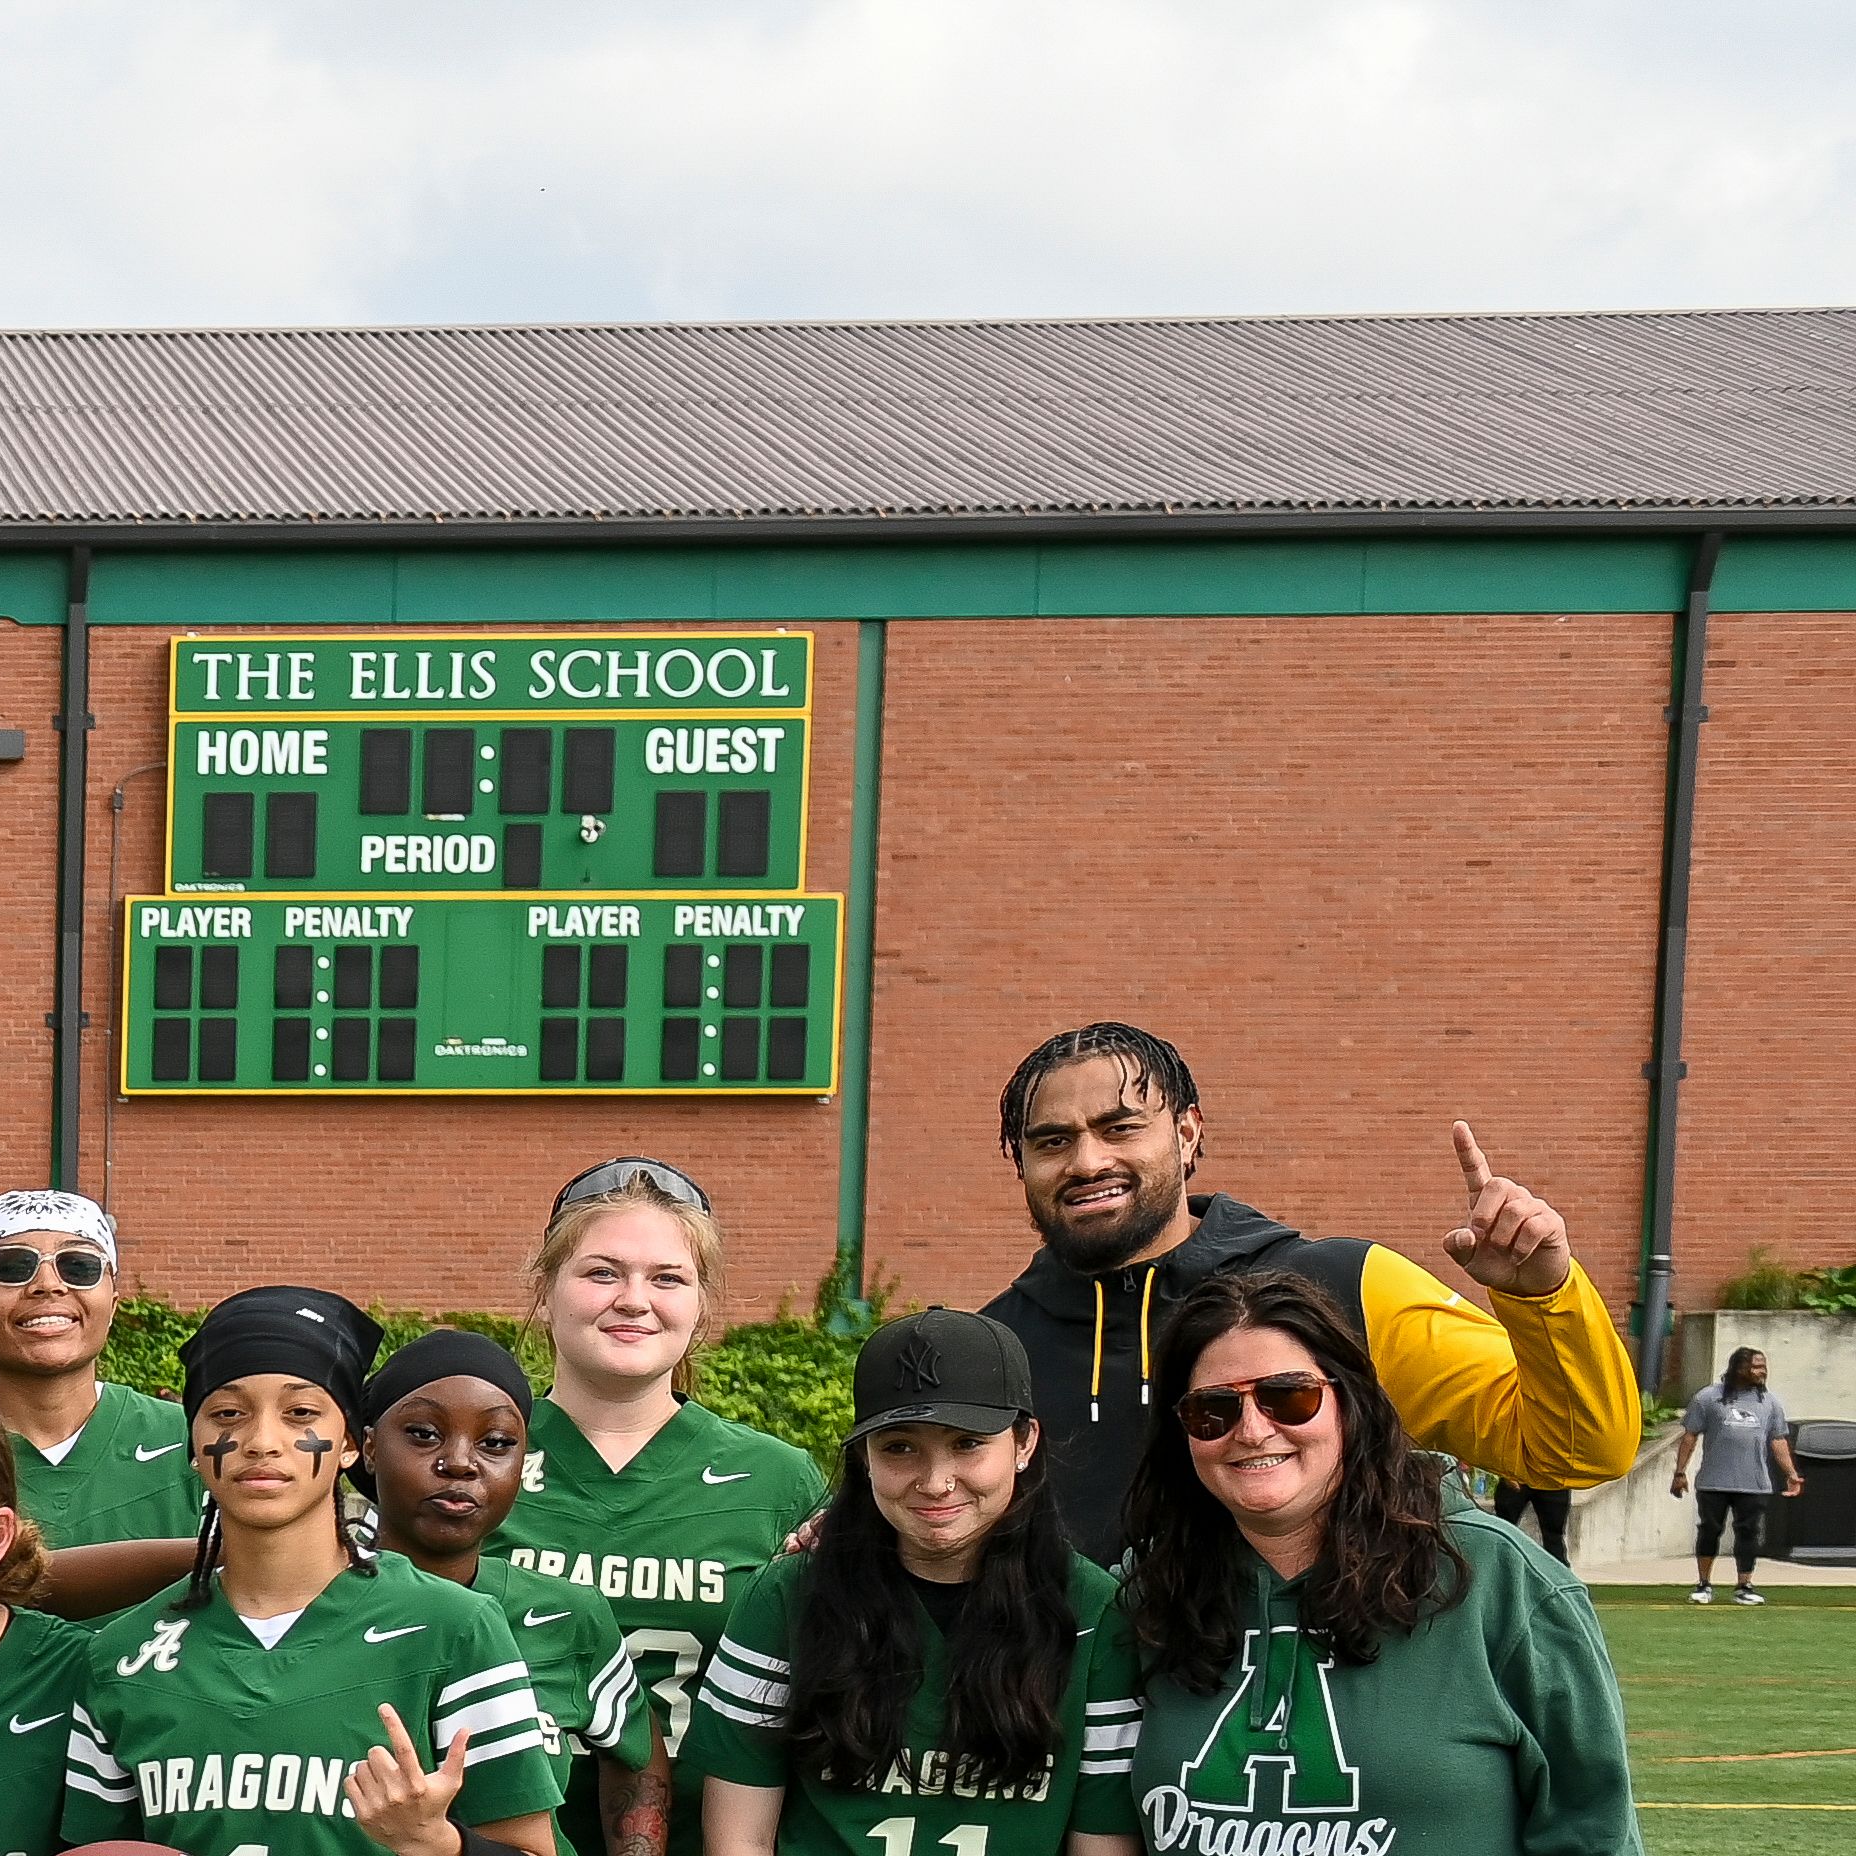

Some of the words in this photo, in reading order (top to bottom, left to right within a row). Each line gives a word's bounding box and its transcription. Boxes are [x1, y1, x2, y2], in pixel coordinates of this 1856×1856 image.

[192, 652, 315, 700] THE
[350, 650, 496, 699] ELLIS
[528, 648, 790, 699] SCHOOL
[197, 729, 328, 776] HOME
[645, 727, 785, 774] GUEST
[360, 834, 496, 874] PERIOD
[141, 907, 252, 938] PLAYER
[285, 906, 414, 938] PENALTY
[528, 905, 640, 938] PLAYER
[674, 905, 805, 937] PENALTY
